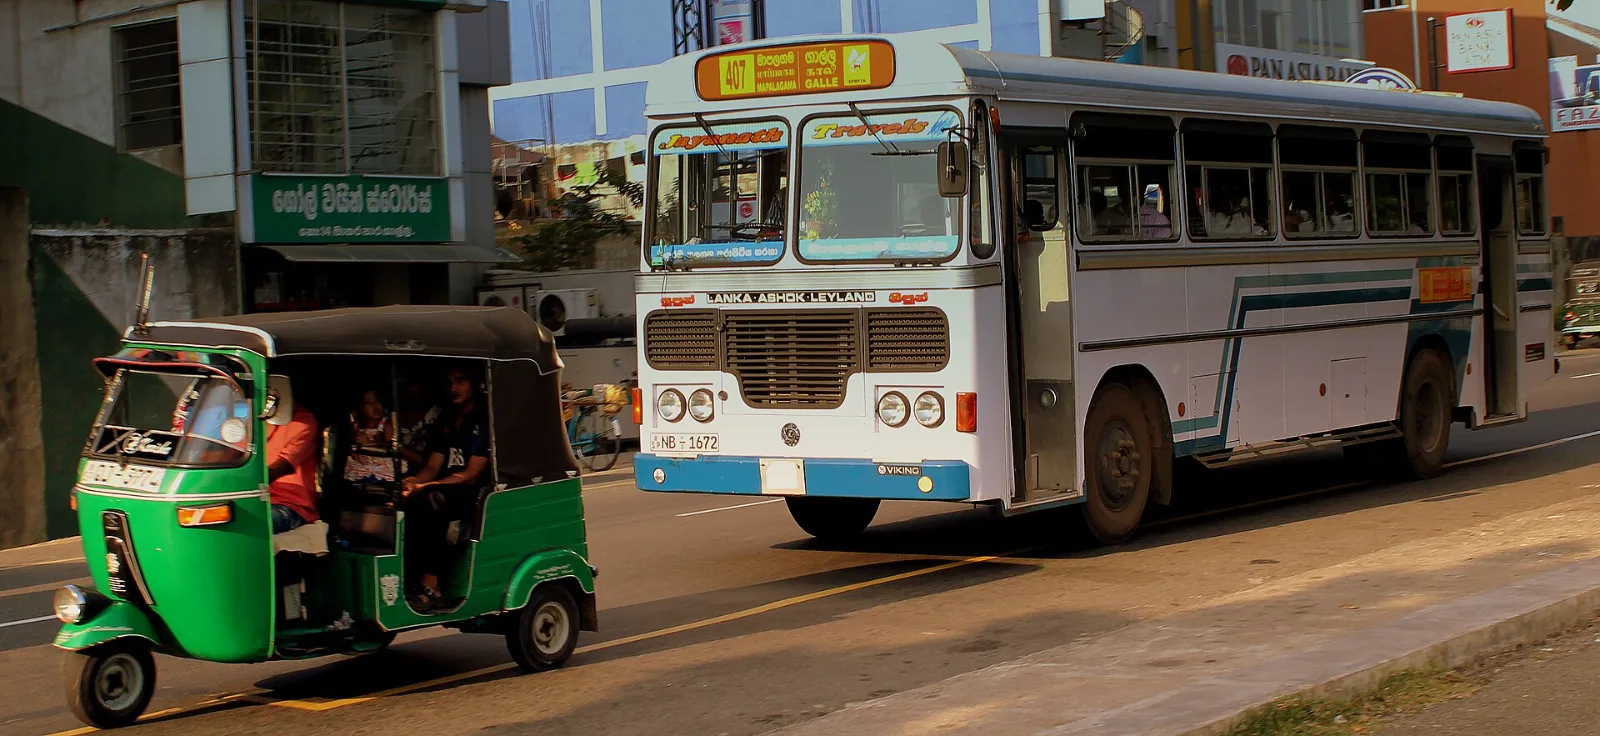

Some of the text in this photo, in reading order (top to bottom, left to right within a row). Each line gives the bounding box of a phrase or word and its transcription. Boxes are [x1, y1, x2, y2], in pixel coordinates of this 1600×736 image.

[805, 47, 836, 66] ගාල්ල
[725, 60, 747, 91] 407
[1249, 56, 1360, 81] PAN ASIA BAN
[757, 80, 797, 92] MAPALAGAMA
[805, 77, 839, 89] GALLE
[658, 127, 784, 149] Jayanath
[812, 118, 929, 139] Travels
[321, 182, 364, 213] වයින්
[707, 291, 875, 303] LANKA ASHOK LEYLAND
[661, 435, 676, 449] NB
[689, 436, 717, 449] 1672
[886, 466, 919, 475] VIKING
